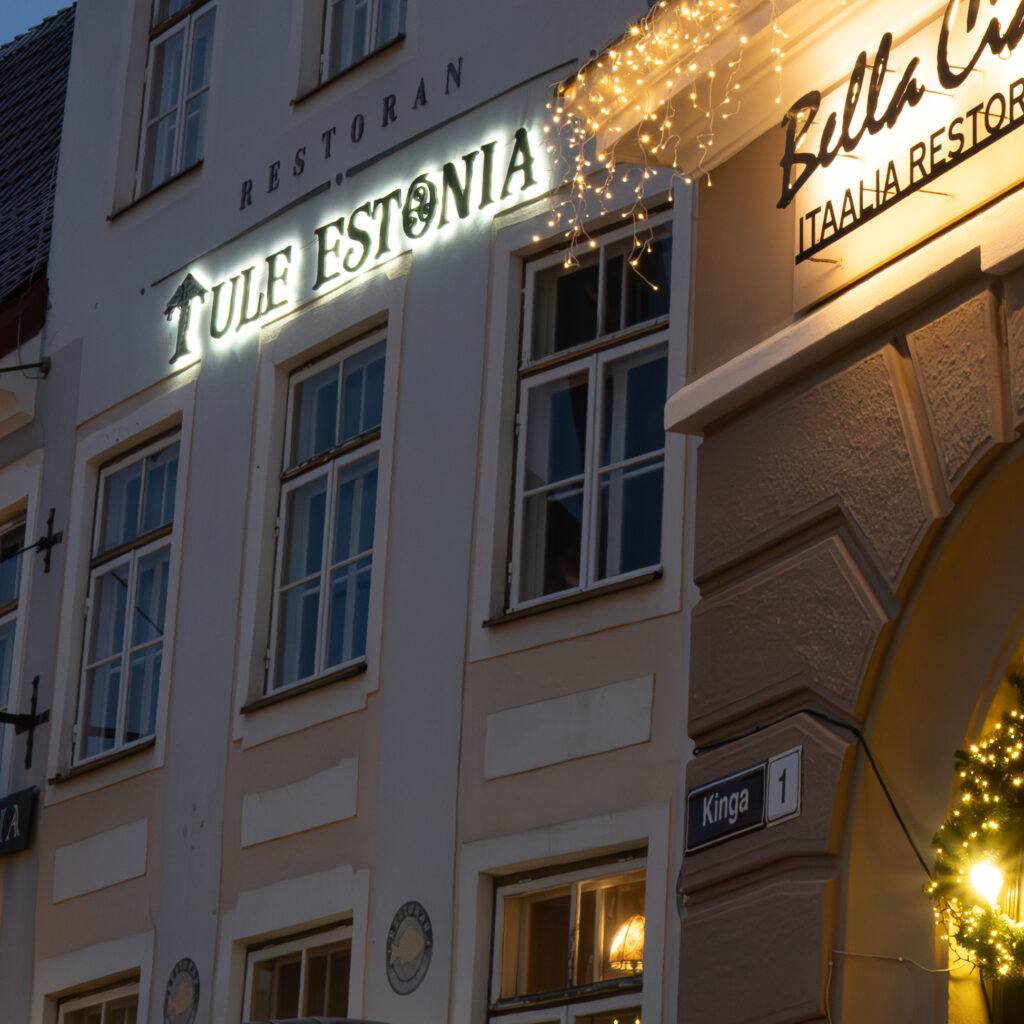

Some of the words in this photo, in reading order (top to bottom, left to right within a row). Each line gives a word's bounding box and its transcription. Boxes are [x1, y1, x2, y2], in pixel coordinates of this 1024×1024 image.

[239, 57, 464, 210] RESTORAN
[777, 32, 925, 210] Bella
[164, 246, 293, 365] TULE
[312, 127, 539, 291] ESTONIA
[798, 160, 900, 255] ITAALIA
[702, 788, 749, 827] Kinga
[778, 768, 787, 804] 1
